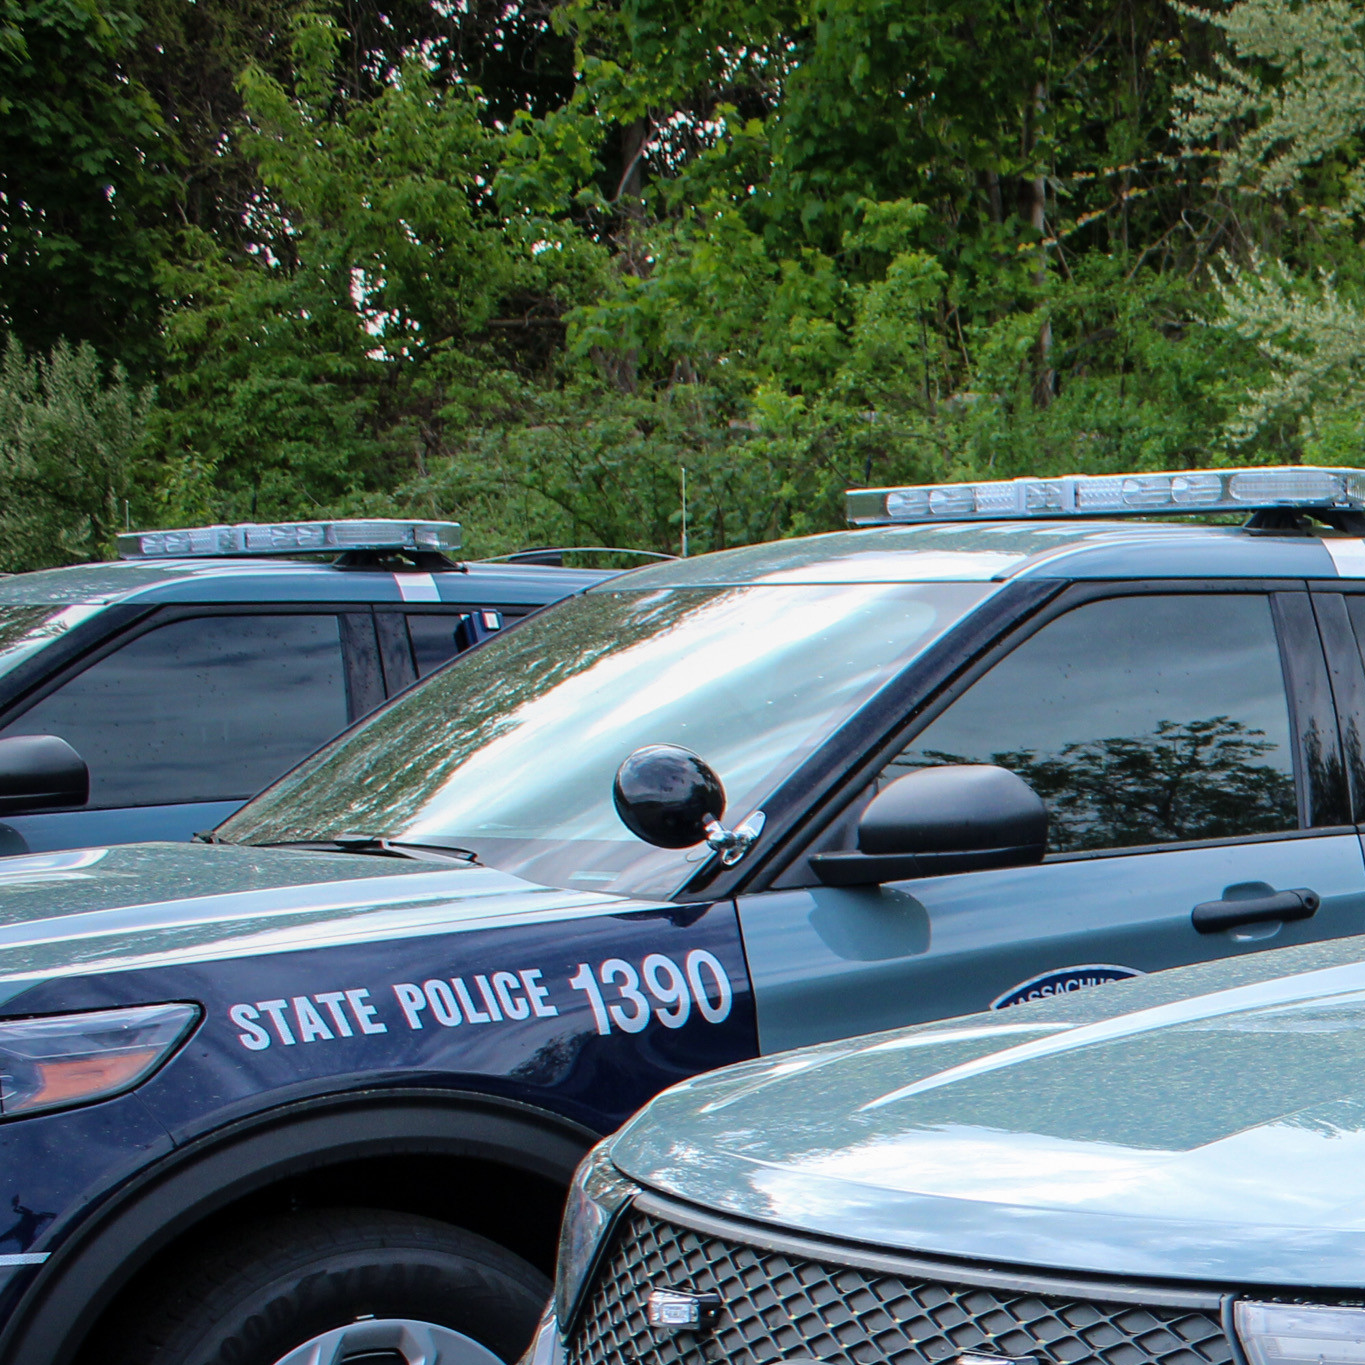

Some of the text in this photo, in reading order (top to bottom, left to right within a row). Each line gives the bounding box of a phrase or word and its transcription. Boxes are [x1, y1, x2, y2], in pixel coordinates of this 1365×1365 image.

[229, 947, 733, 1051] STATE POLICE 1390
